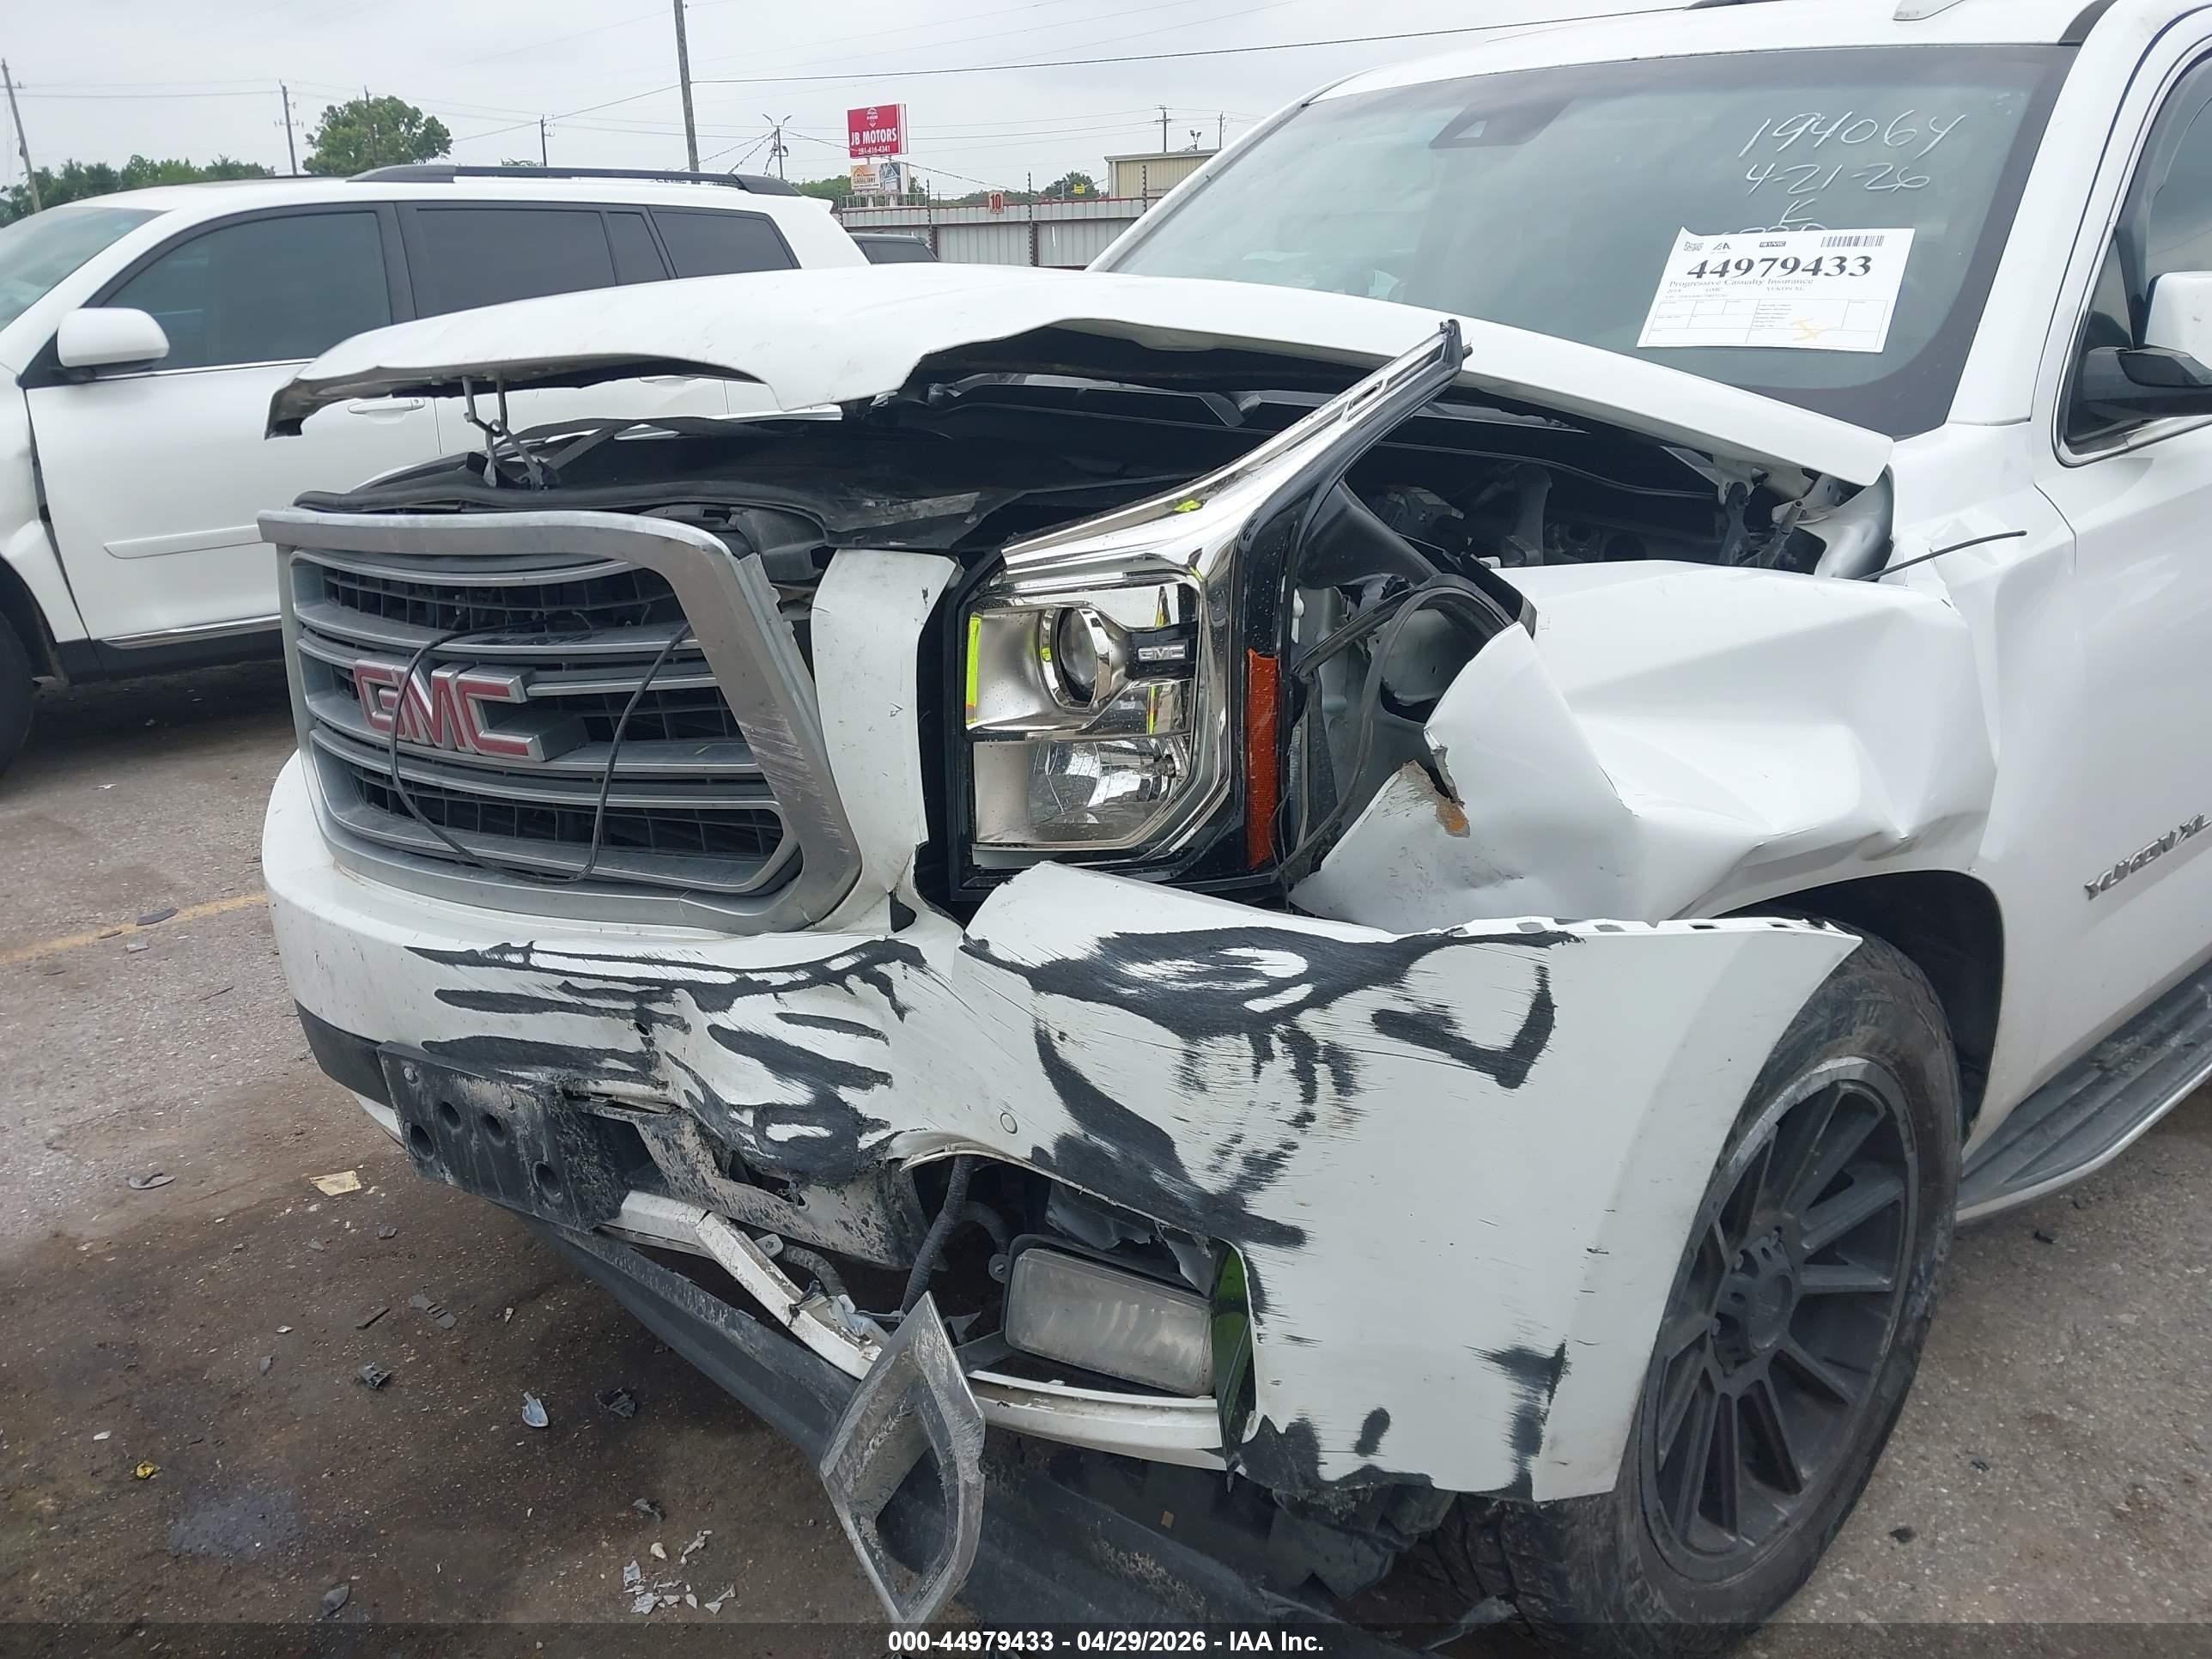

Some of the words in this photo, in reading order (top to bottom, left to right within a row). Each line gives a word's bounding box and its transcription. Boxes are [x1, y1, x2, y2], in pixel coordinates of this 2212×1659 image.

[851, 132, 860, 146] JB
[862, 128, 896, 144] MOTORS
[1738, 110, 1966, 160] 194064
[1746, 162, 1930, 195] 4-21-26
[990, 194, 1001, 210] 10
[1686, 256, 1872, 279] 44979433
[1669, 279, 1722, 289] Progressive
[1724, 277, 1765, 288] Casualty
[1767, 276, 1814, 286] Insurance
[1137, 643, 1186, 661] GMC
[353, 658, 547, 763] GMC
[2084, 830, 2176, 902] YUKON
